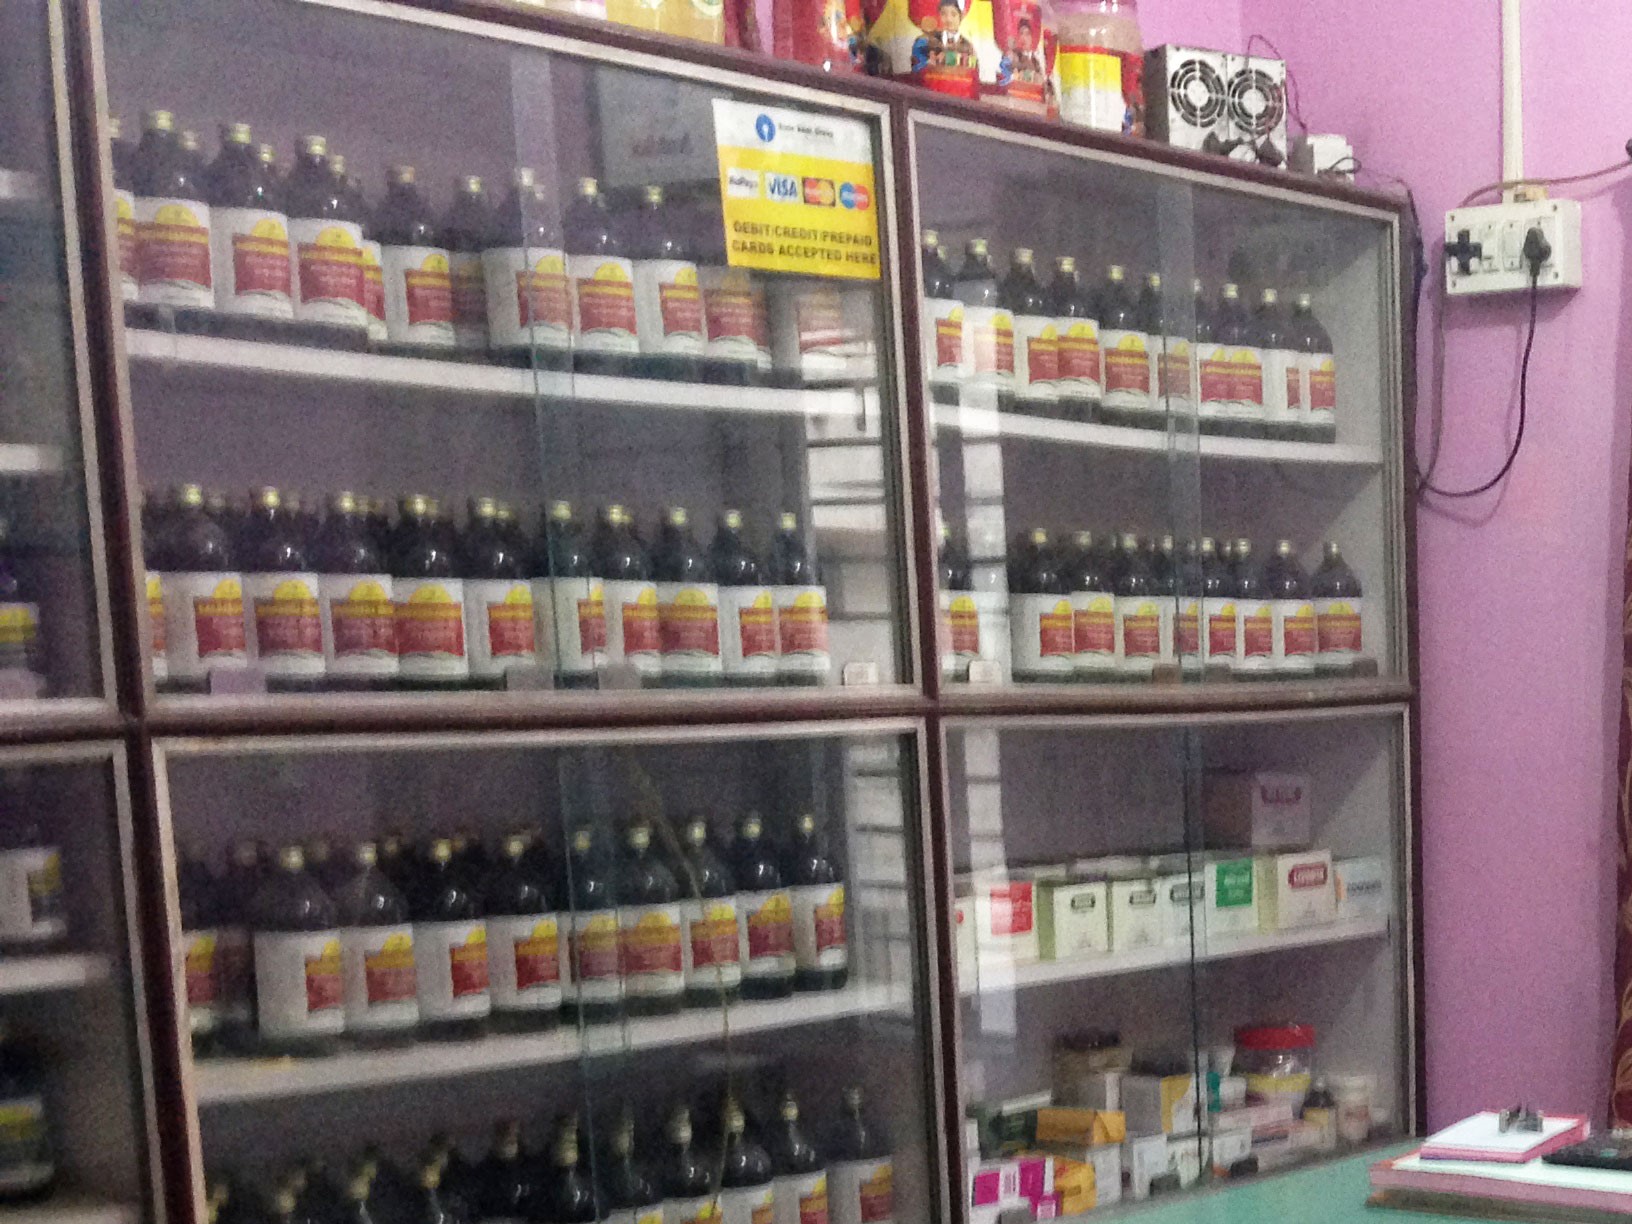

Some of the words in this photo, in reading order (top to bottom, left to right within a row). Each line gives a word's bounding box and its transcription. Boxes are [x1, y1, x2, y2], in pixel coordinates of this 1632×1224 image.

[768, 176, 798, 198] VISA
[731, 239, 775, 255] CARDS
[778, 244, 842, 261] ACCEPTED
[845, 251, 877, 265] HERE
